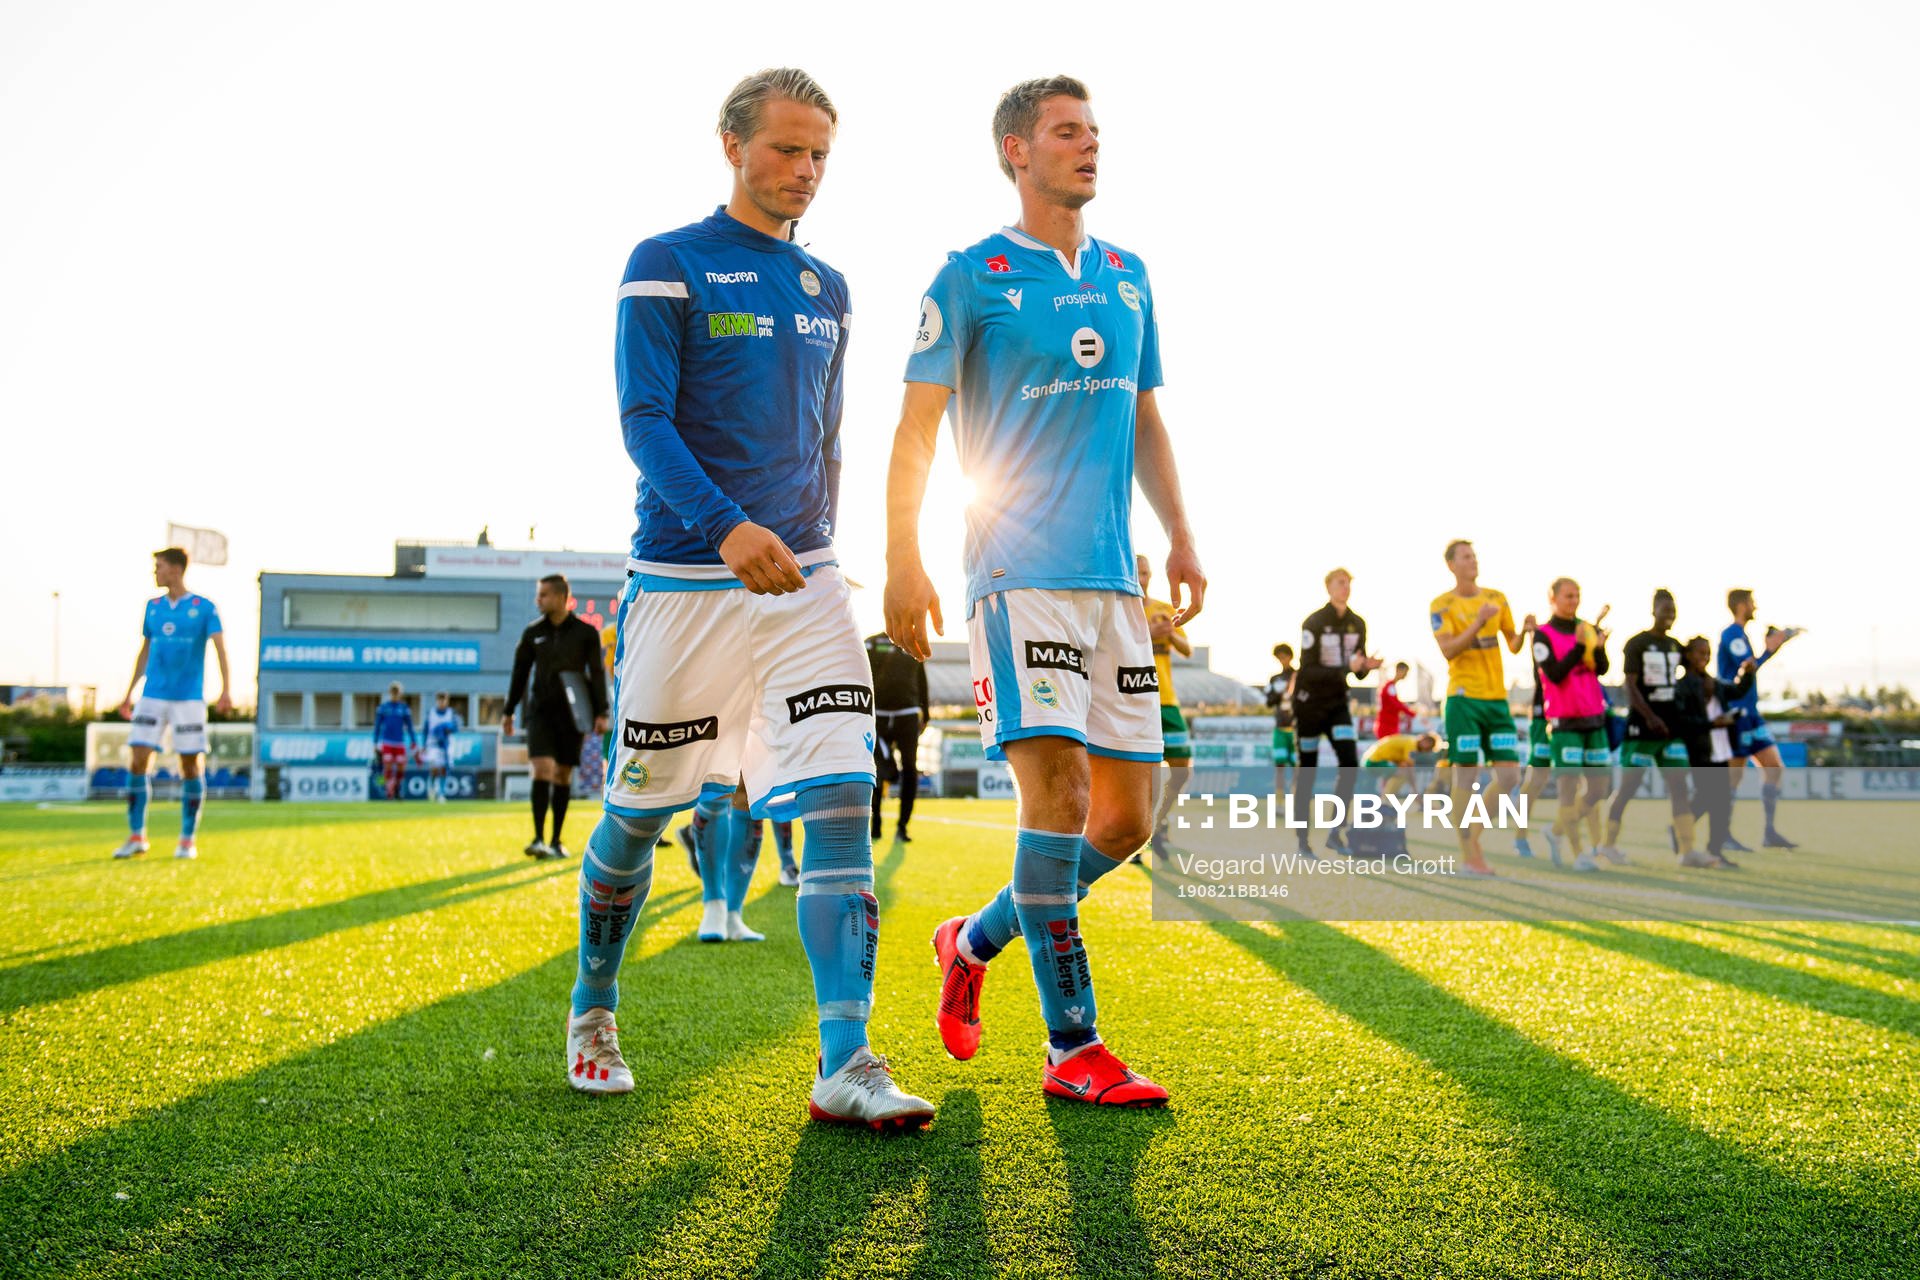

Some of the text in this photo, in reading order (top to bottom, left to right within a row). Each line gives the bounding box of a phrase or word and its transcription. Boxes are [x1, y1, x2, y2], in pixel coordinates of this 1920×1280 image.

[705, 271, 758, 284] macron
[1053, 291, 1108, 313] prosjektil
[708, 312, 757, 338] KIWI
[756, 315, 774, 326] mini
[758, 326, 773, 339] pris
[1021, 378, 1081, 401] Sandnes
[263, 645, 478, 665] JESSHEIM STORSENTER
[794, 690, 872, 717] MASIV
[627, 720, 713, 745] MASIV
[298, 776, 362, 796] OBOS
[408, 776, 473, 796] OOS
[861, 931, 878, 982] Berge
[1056, 953, 1076, 998] Berge
[1073, 949, 1092, 990] Block
